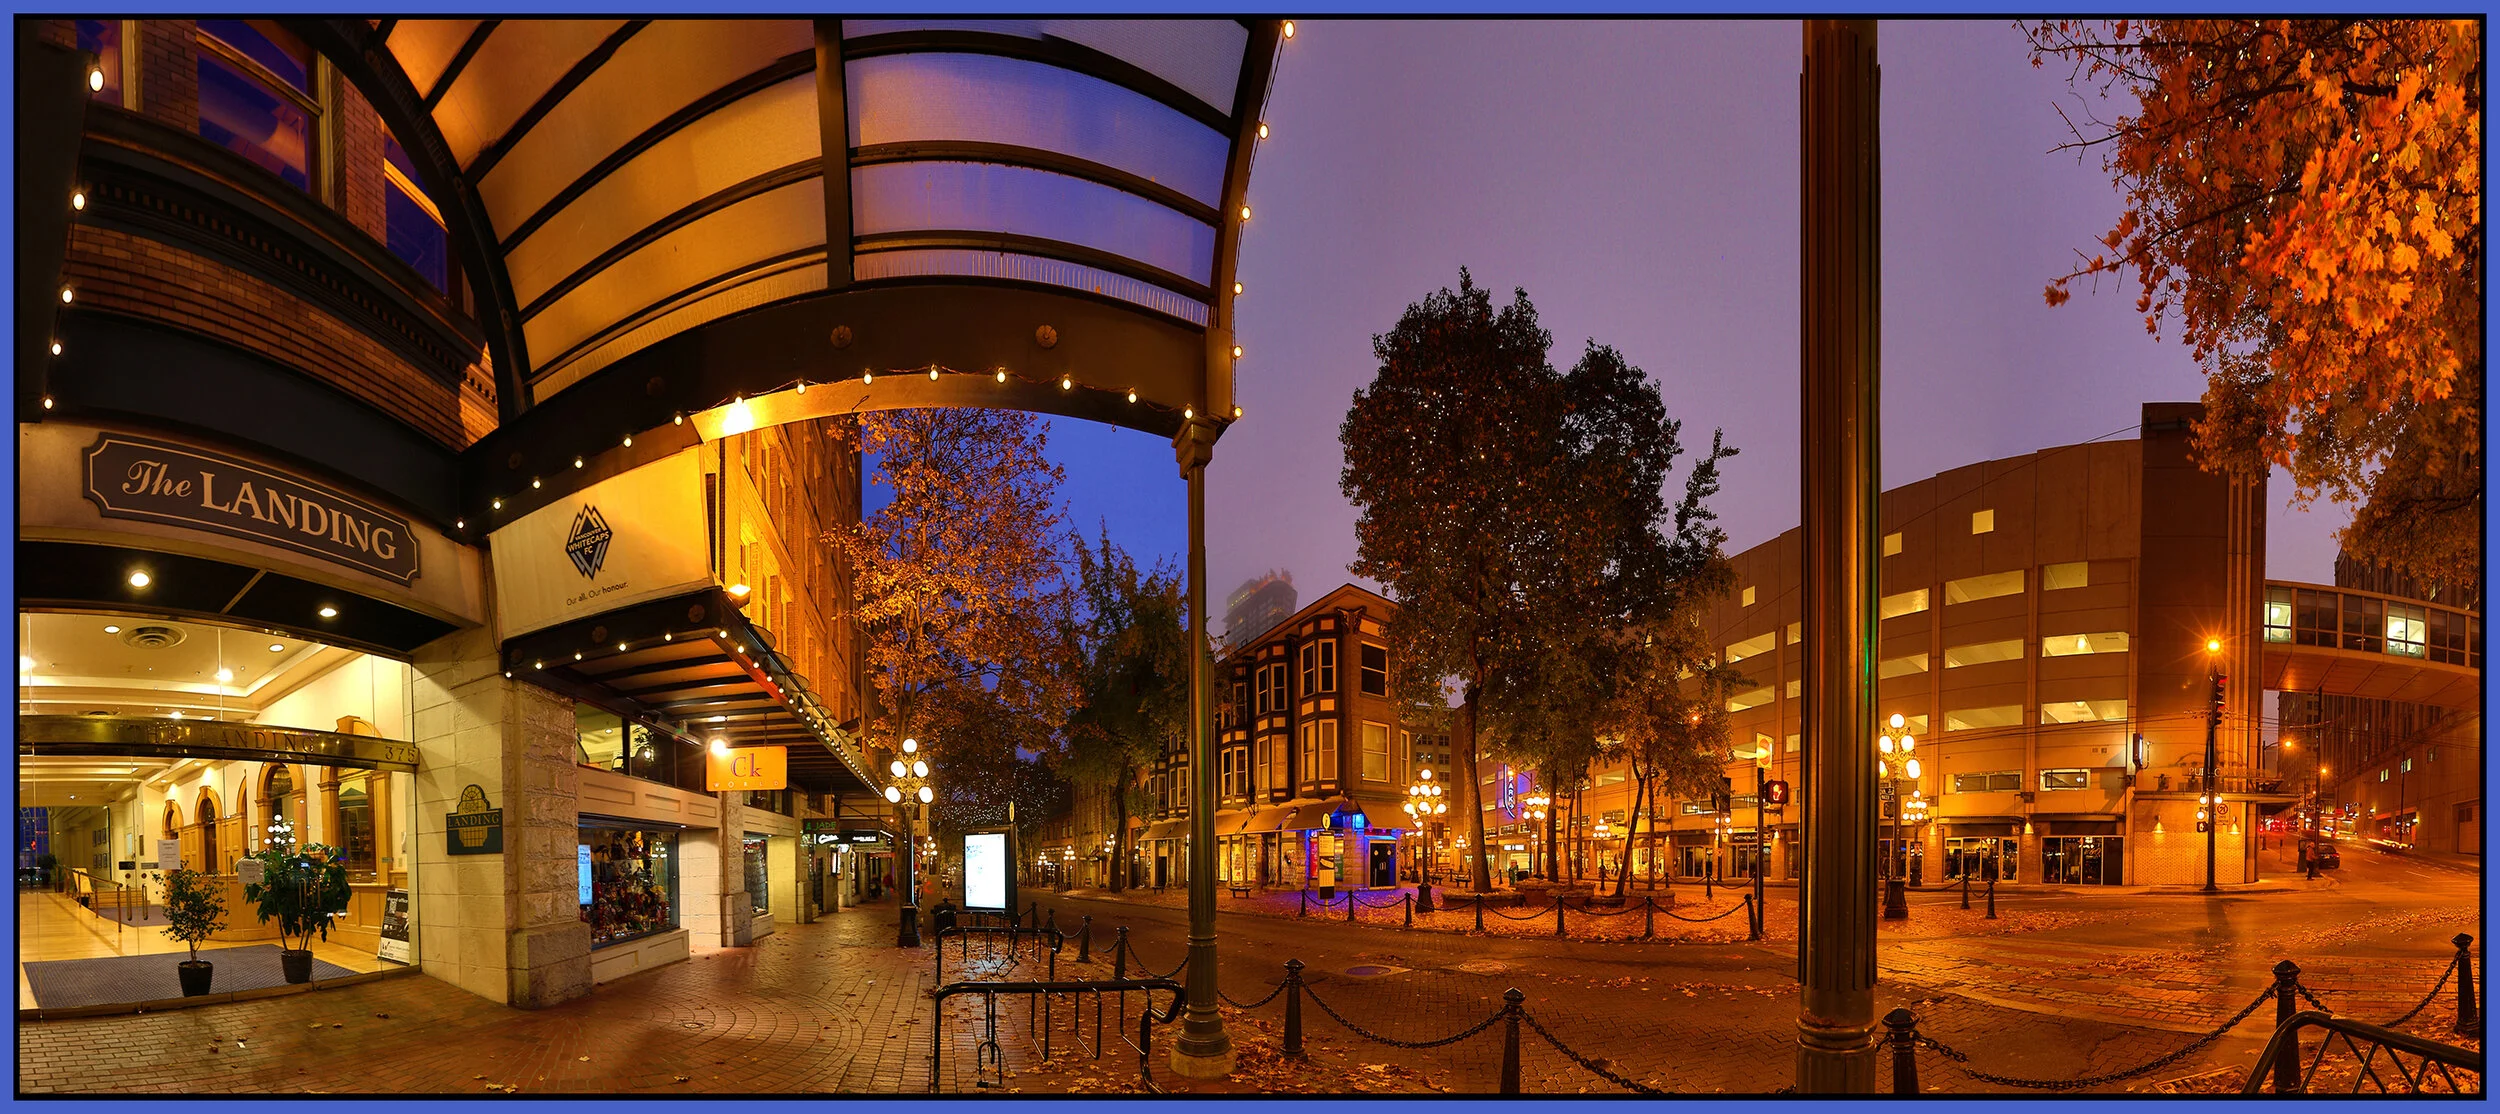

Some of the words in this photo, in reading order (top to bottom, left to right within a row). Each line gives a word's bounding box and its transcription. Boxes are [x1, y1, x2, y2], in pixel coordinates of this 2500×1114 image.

[122, 460, 193, 498] The
[200, 471, 397, 559] LANDING
[567, 531, 610, 553] WHITECAPS
[575, 527, 602, 541] VANCOUVER
[583, 545, 594, 556] FC
[566, 597, 577, 606] Our
[588, 589, 601, 599] Our
[602, 581, 629, 594] honour.
[201, 726, 315, 754] LANDING
[384, 744, 416, 763] 375
[730, 753, 763, 778] Ck
[447, 813, 500, 827] LANDING
